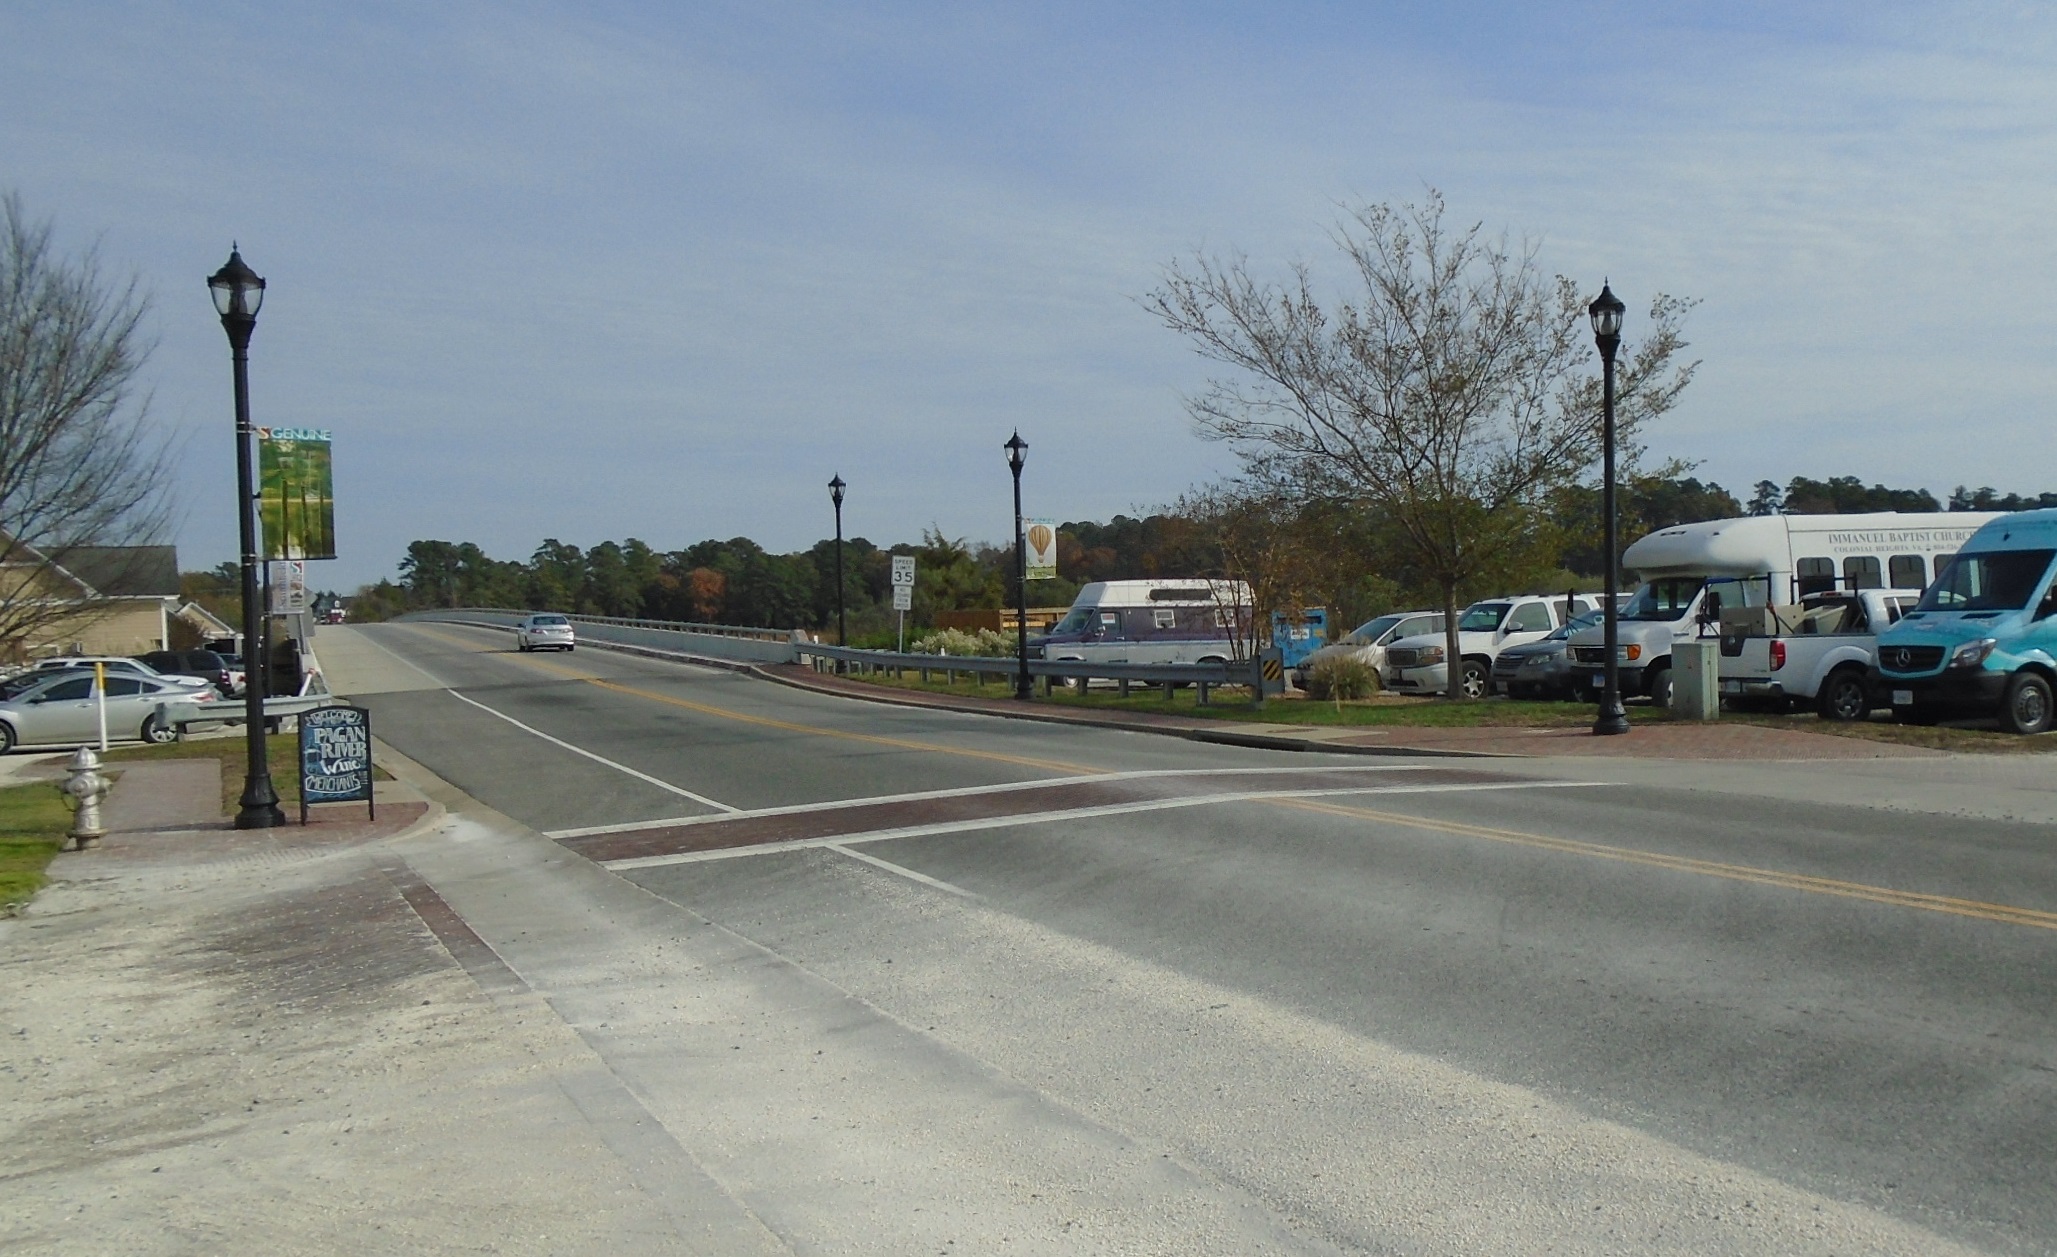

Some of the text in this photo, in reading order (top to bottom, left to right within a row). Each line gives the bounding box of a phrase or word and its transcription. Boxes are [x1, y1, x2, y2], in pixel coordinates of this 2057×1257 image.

[271, 427, 331, 440] GENUINE
[1828, 532, 1886, 544] IMMANUEL
[1889, 531, 1931, 543] BAPTIST
[1834, 545, 1872, 553] COLONIAL
[894, 571, 913, 583] 35
[311, 710, 356, 723] WELCOME
[314, 726, 365, 743] PAGAN
[320, 741, 366, 760] RIVER
[320, 758, 360, 775] Wine
[307, 775, 360, 791] MERCHANTS
